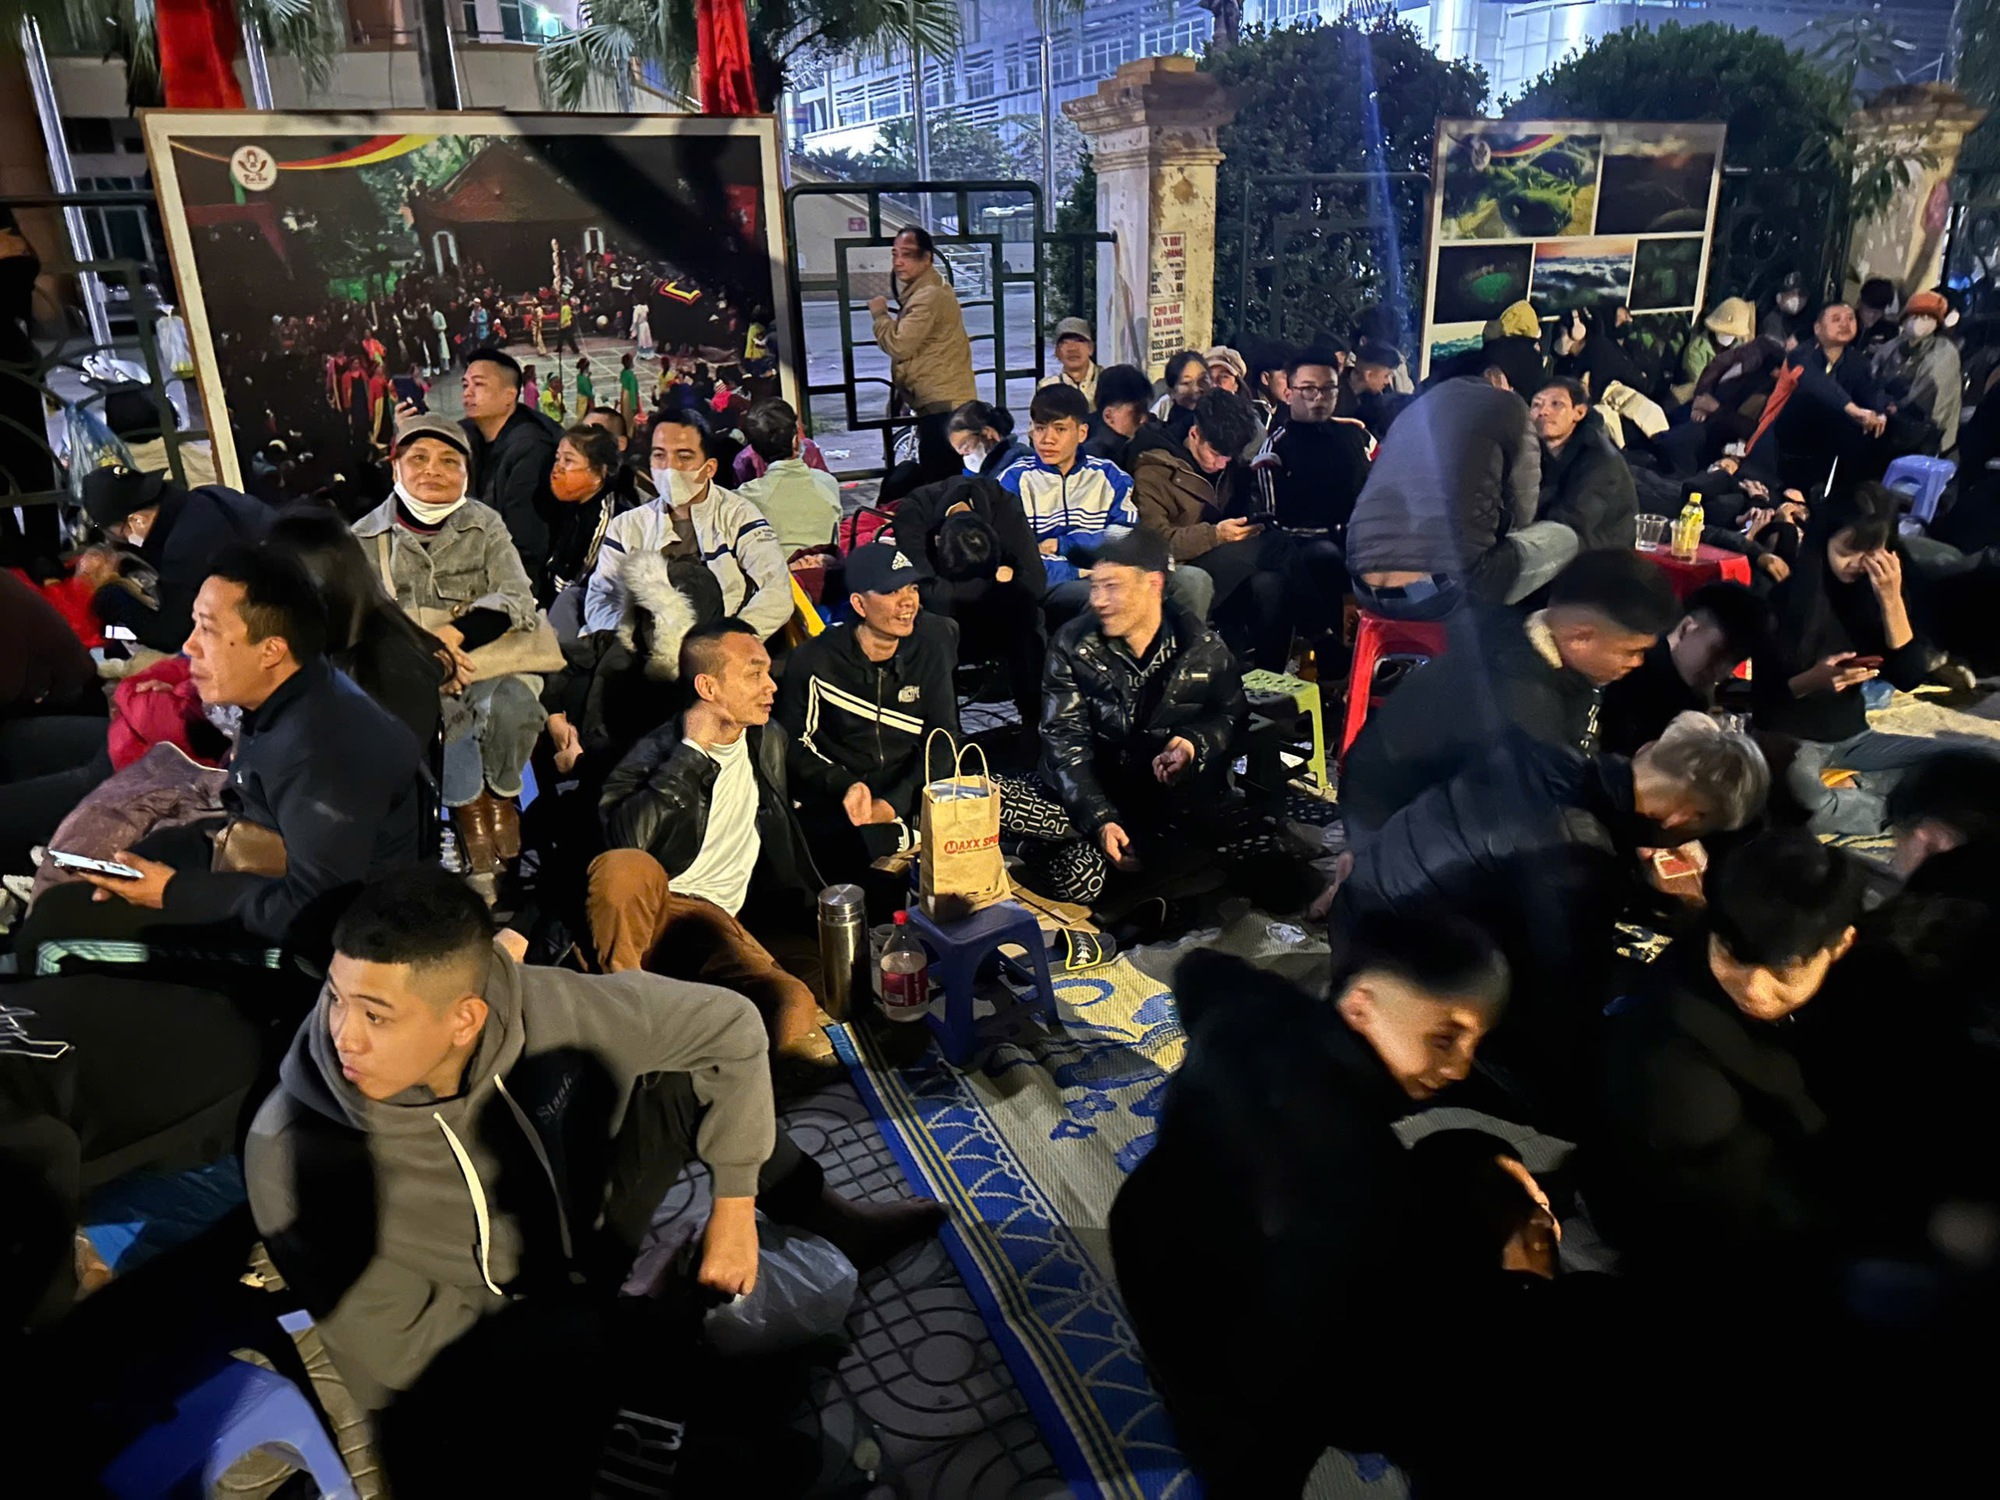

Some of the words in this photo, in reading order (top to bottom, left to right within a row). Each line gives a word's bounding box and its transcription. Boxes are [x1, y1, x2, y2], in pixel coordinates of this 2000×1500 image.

[1153, 306, 1167, 316] CHO
[1169, 304, 1180, 314] VAY
[944, 839, 980, 854] MAXX
